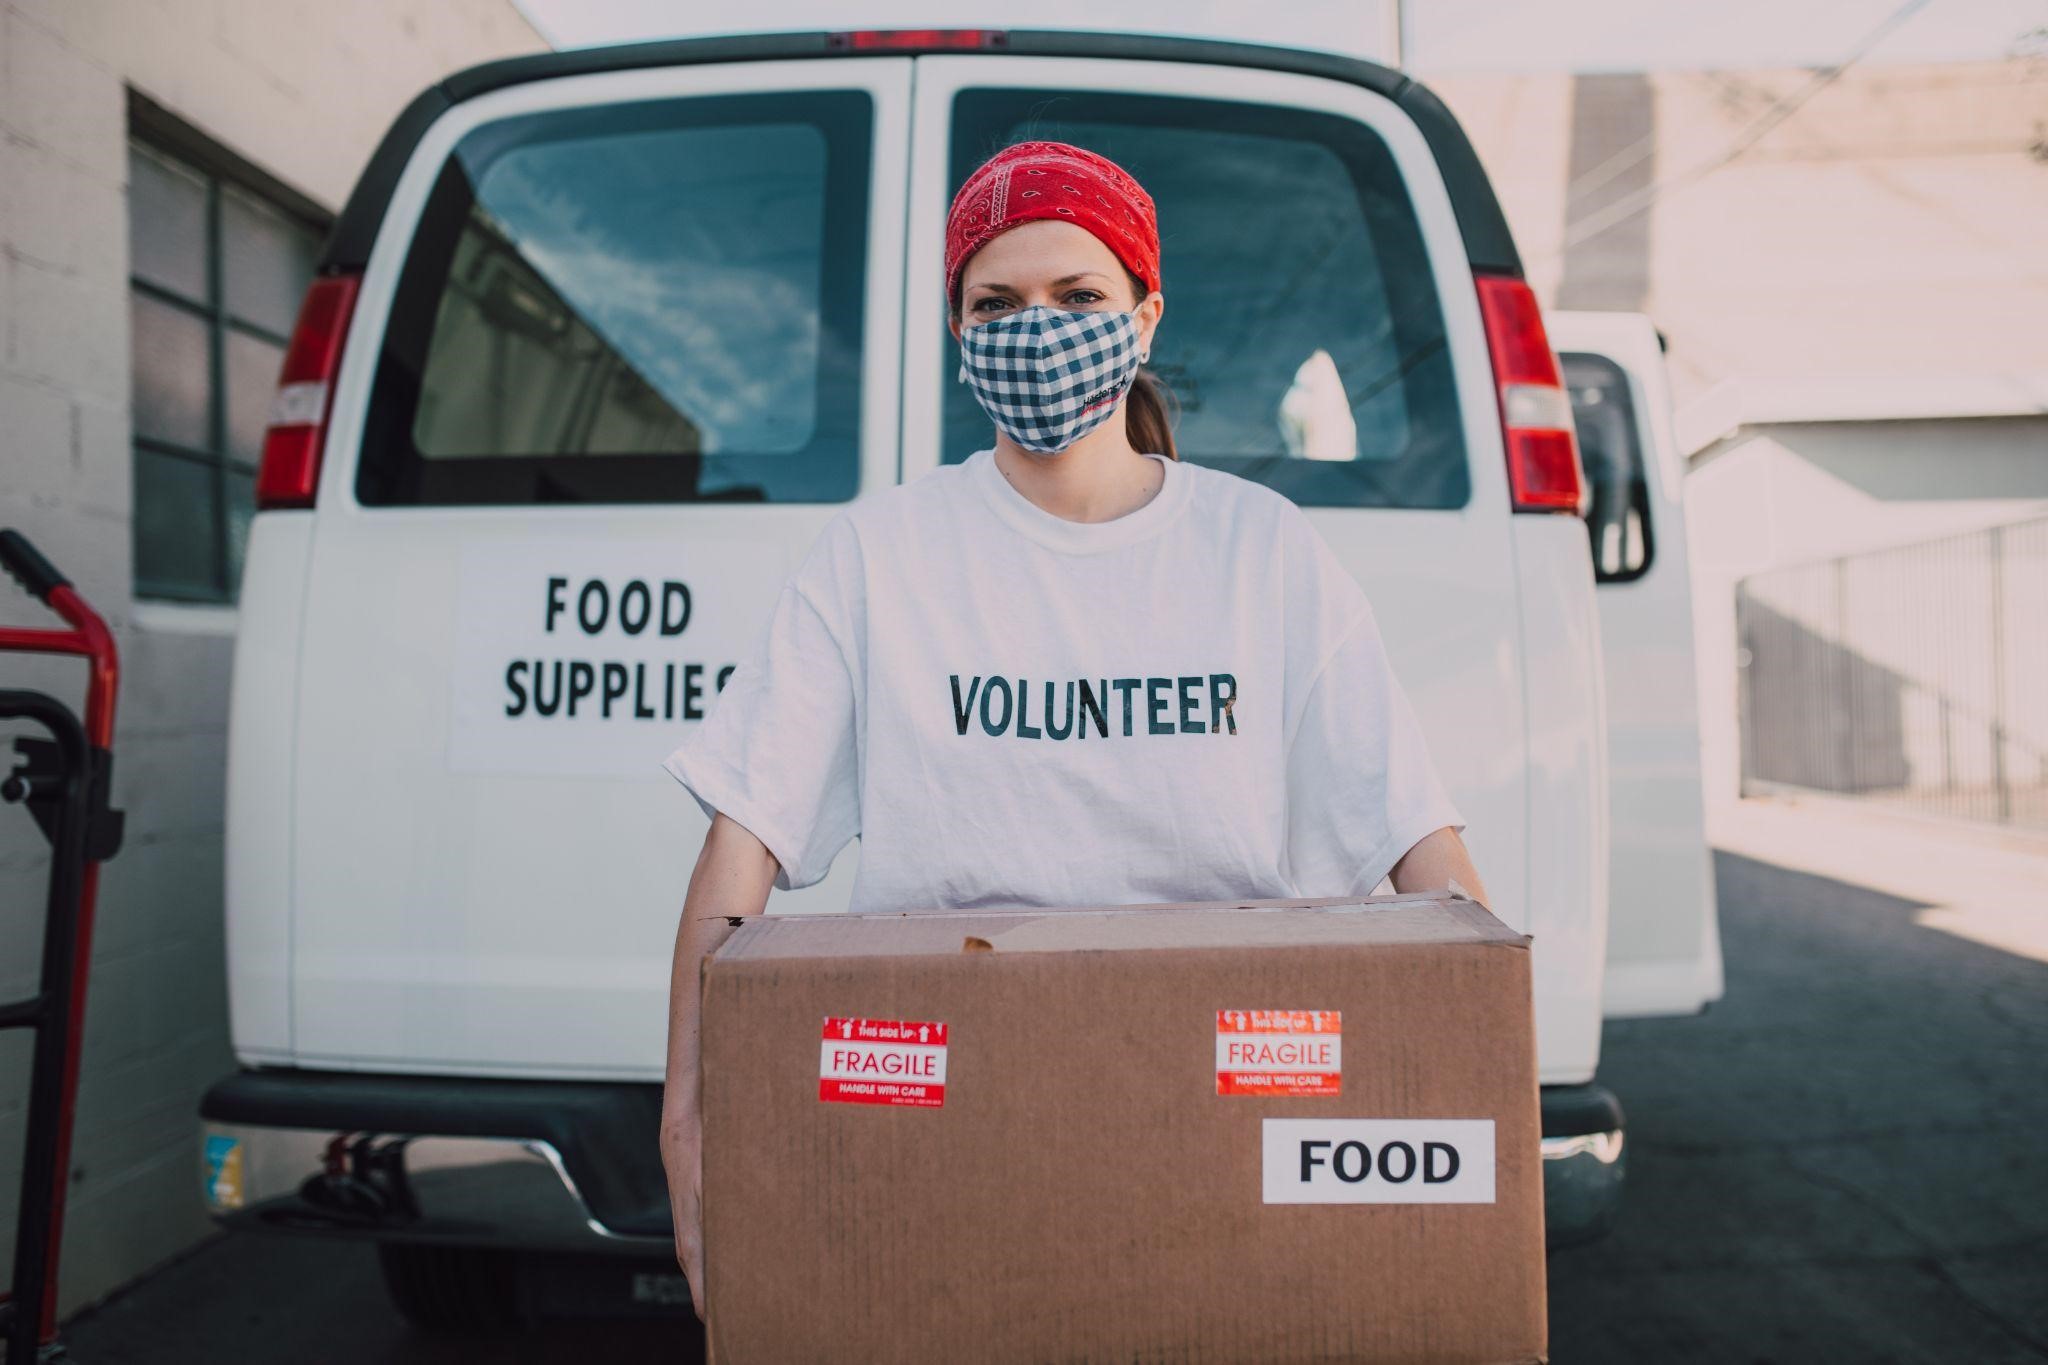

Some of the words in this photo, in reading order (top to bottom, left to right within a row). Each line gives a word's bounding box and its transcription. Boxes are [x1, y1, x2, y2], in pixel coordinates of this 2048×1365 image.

[546, 577, 692, 636] FOOD
[949, 673, 1238, 741] VOLUNTEER
[858, 1026, 878, 1038] THIS
[879, 1027, 899, 1039] SIDE
[901, 1027, 914, 1039] UP
[833, 1050, 936, 1077] FRAGILE
[1228, 1042, 1331, 1065] FRAGILE
[839, 1083, 876, 1095] HANDLE
[877, 1085, 900, 1097] WITH
[900, 1086, 927, 1098] CARE
[1235, 1075, 1272, 1086] HANDLE
[1273, 1075, 1296, 1086] WITH
[1297, 1075, 1323, 1086] CARE
[1300, 1140, 1460, 1184] FOOD
